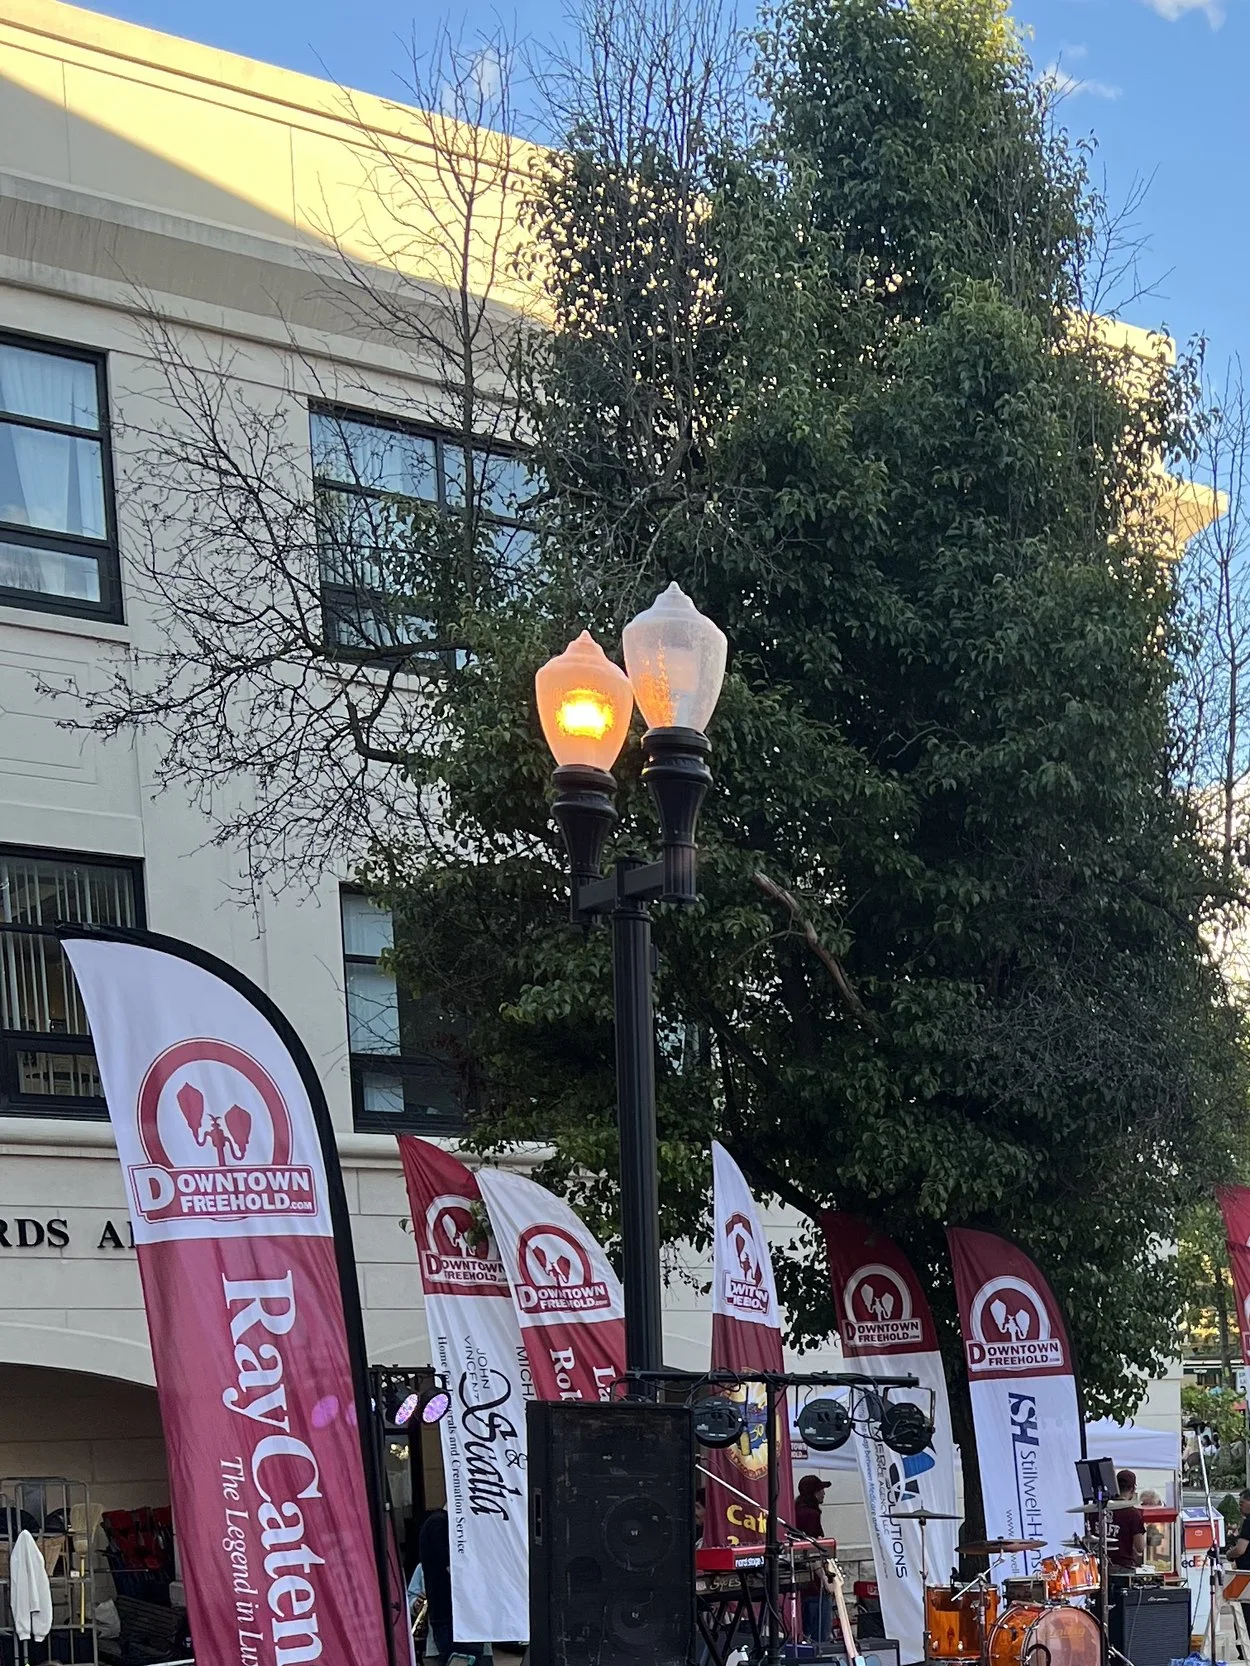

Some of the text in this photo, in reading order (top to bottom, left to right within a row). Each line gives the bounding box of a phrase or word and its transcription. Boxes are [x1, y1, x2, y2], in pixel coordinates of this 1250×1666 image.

[133, 1168, 309, 1212] DOWNTOWN
[181, 1193, 312, 1213] FREEHOLD.COM
[425, 1254, 506, 1275] DOWNTOWN
[515, 1285, 605, 1308] DOWNTOWN
[845, 1321, 919, 1341] DOWNTOWN
[437, 1336, 449, 1368] Home
[464, 1335, 480, 1401] VINCENT
[475, 1348, 491, 1390] JOHN
[968, 1342, 1058, 1364] DOWNTOWN
[446, 1389, 457, 1434] Fnerals
[449, 1437, 460, 1457] and
[220, 1456, 243, 1502] The
[451, 1459, 464, 1514] Cremation
[221, 1507, 251, 1594] Legend
[455, 1517, 467, 1554] Service
[236, 1598, 254, 1622] in
